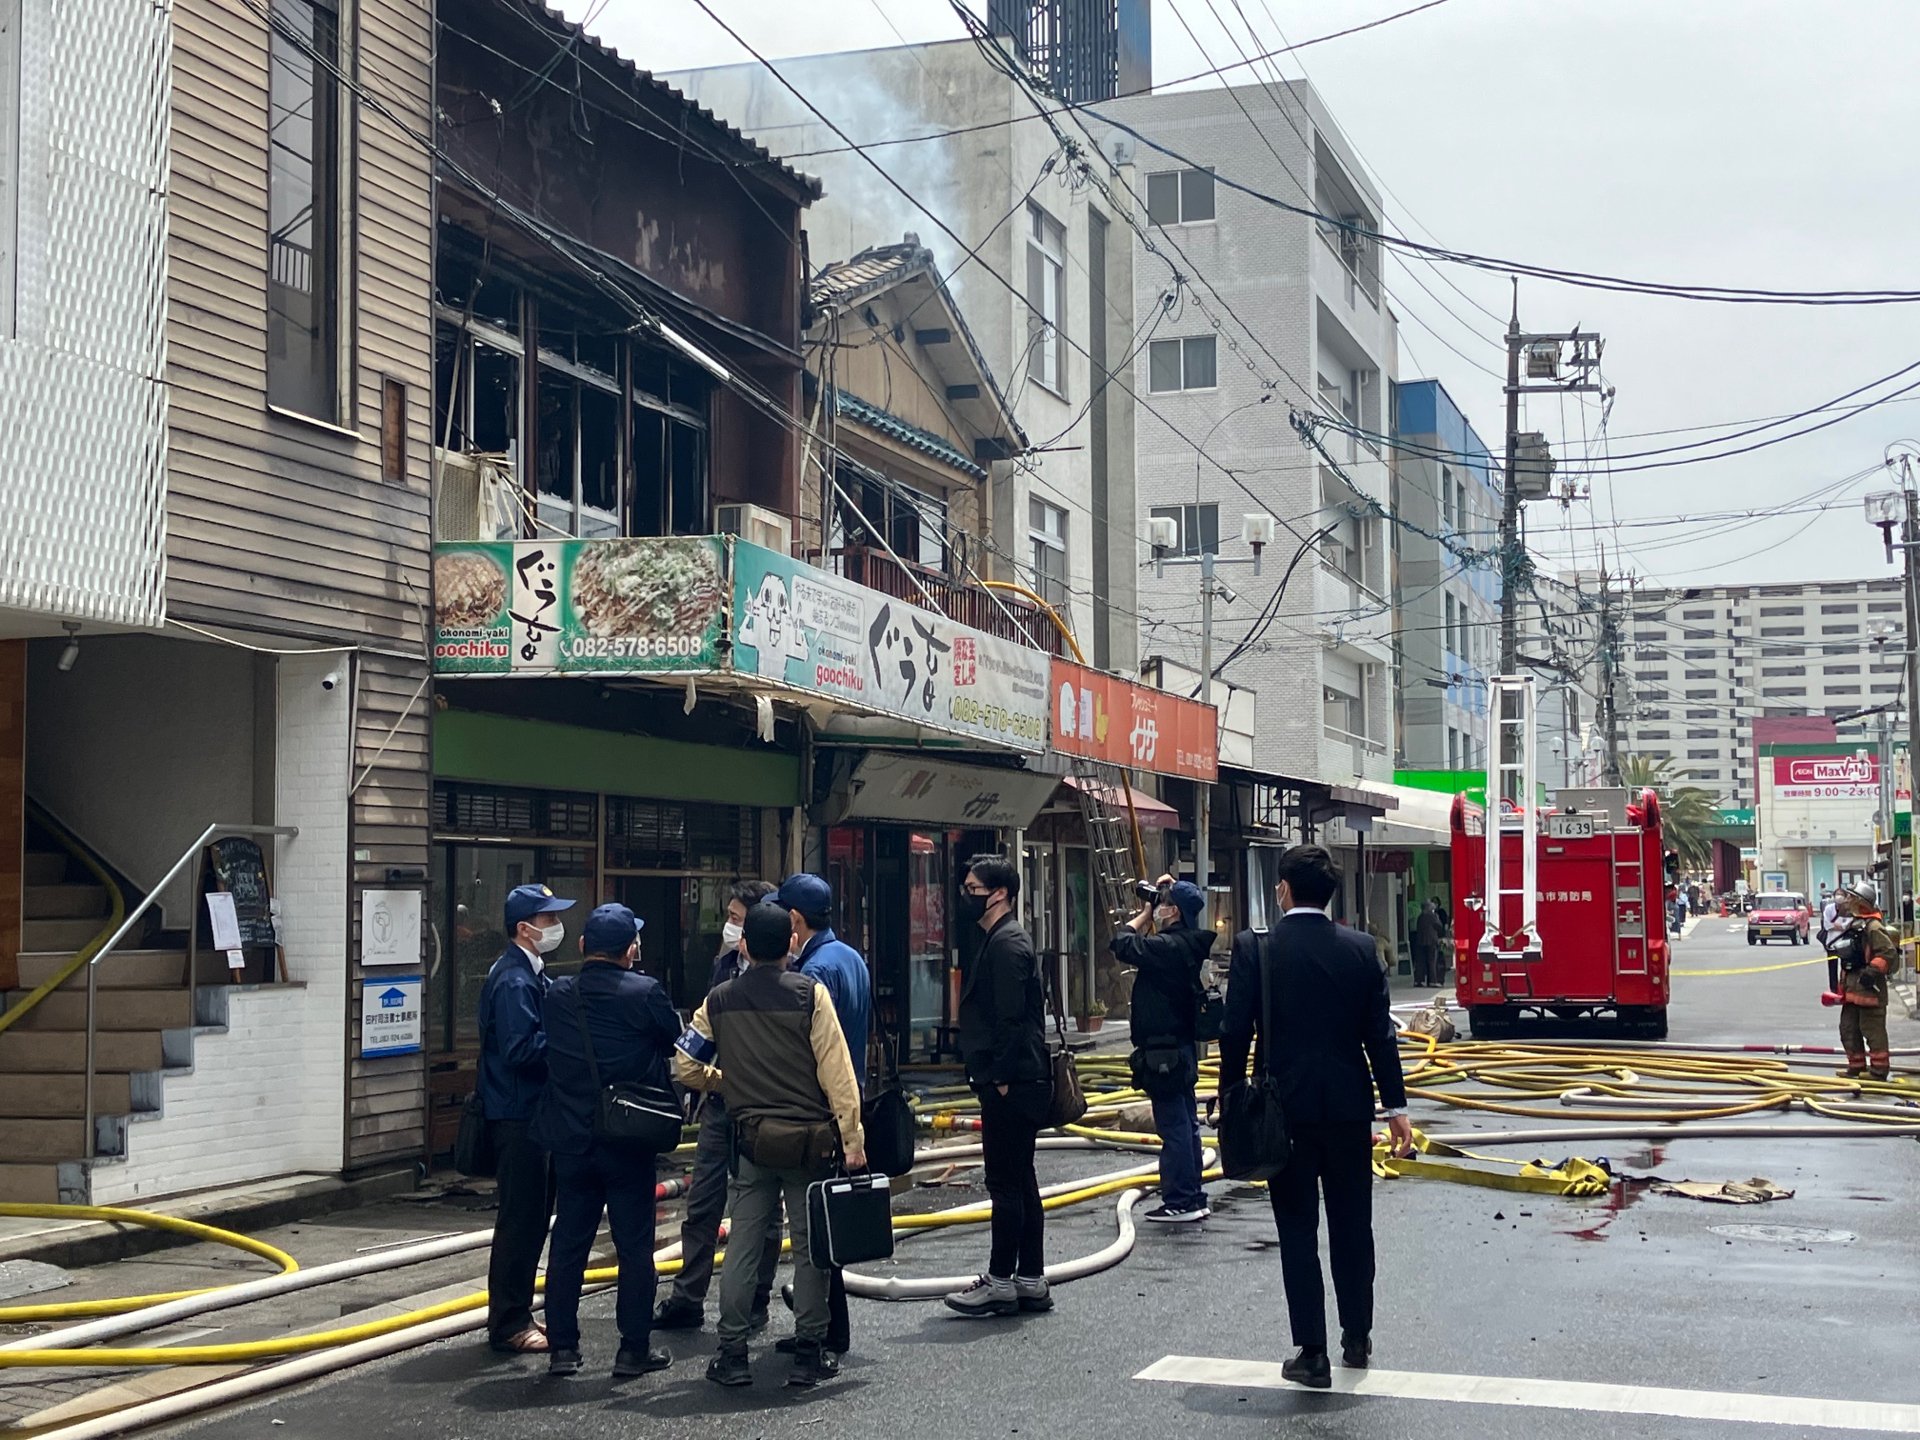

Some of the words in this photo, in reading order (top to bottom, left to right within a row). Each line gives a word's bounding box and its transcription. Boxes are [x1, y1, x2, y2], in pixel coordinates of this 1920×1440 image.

[440, 628, 508, 639] okonomi-yaki
[572, 636, 702, 658] 082-578-6508
[816, 664, 863, 691] goochiku
[953, 696, 1042, 741] 082-578-6508
[1559, 823, 1591, 835] 16-39
